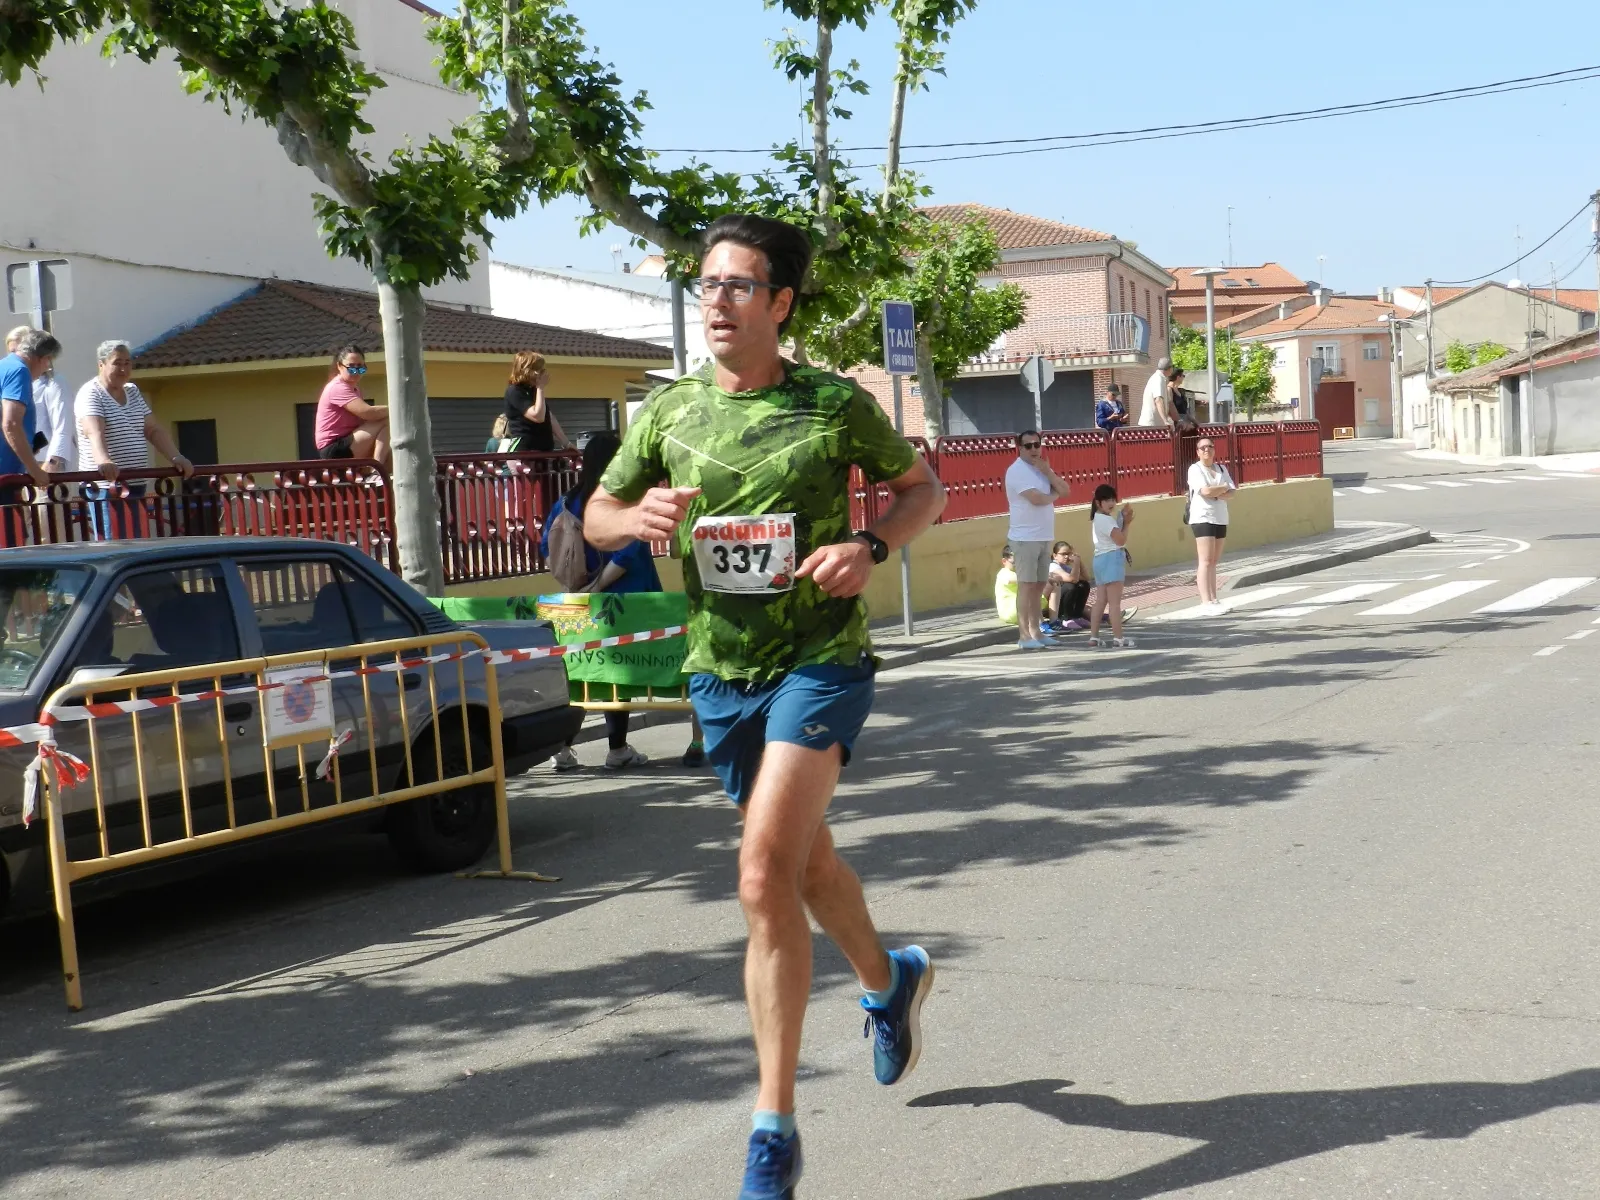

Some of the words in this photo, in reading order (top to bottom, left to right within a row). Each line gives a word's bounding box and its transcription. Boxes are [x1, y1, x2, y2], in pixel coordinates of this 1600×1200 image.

[888, 328, 914, 348] TAXI
[712, 544, 773, 574] 337
[570, 648, 605, 666] SAN
